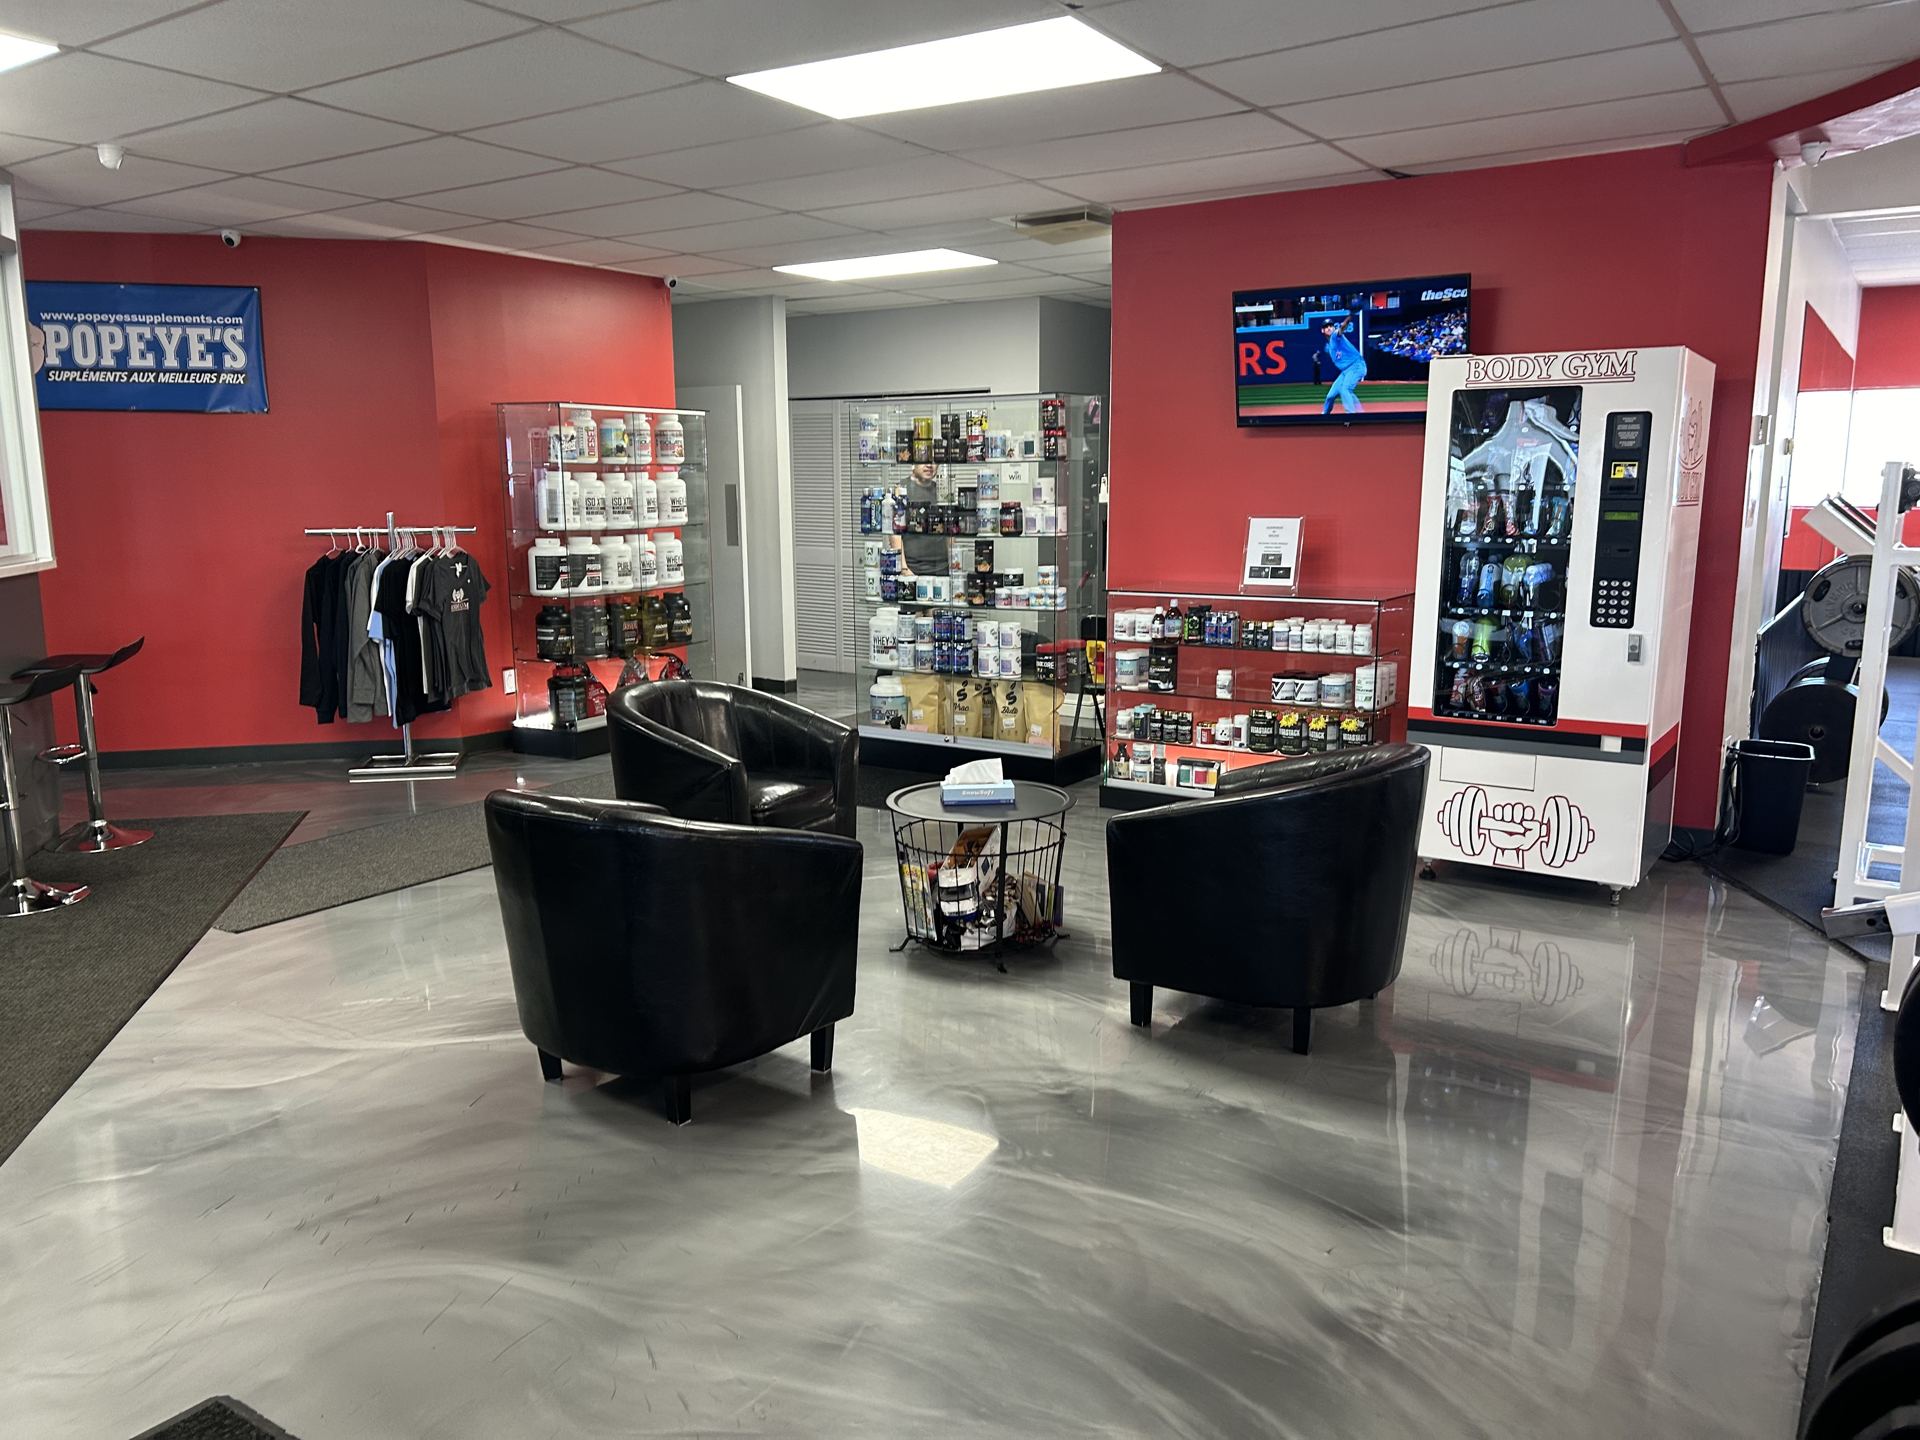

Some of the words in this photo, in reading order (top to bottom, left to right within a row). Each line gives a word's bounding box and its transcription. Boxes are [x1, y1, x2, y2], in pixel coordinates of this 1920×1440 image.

[40, 312, 243, 325] www.popeyessupplements.com
[42, 324, 247, 369] POPEYE'S
[1238, 340, 1288, 377] RS
[48, 368, 128, 383] SUPPLÉMENTS
[130, 371, 156, 383] AUX
[158, 372, 217, 384] MEILLEURS
[219, 373, 246, 385] PRIX
[1466, 354, 1557, 382] BODY
[1562, 351, 1638, 378] GYM
